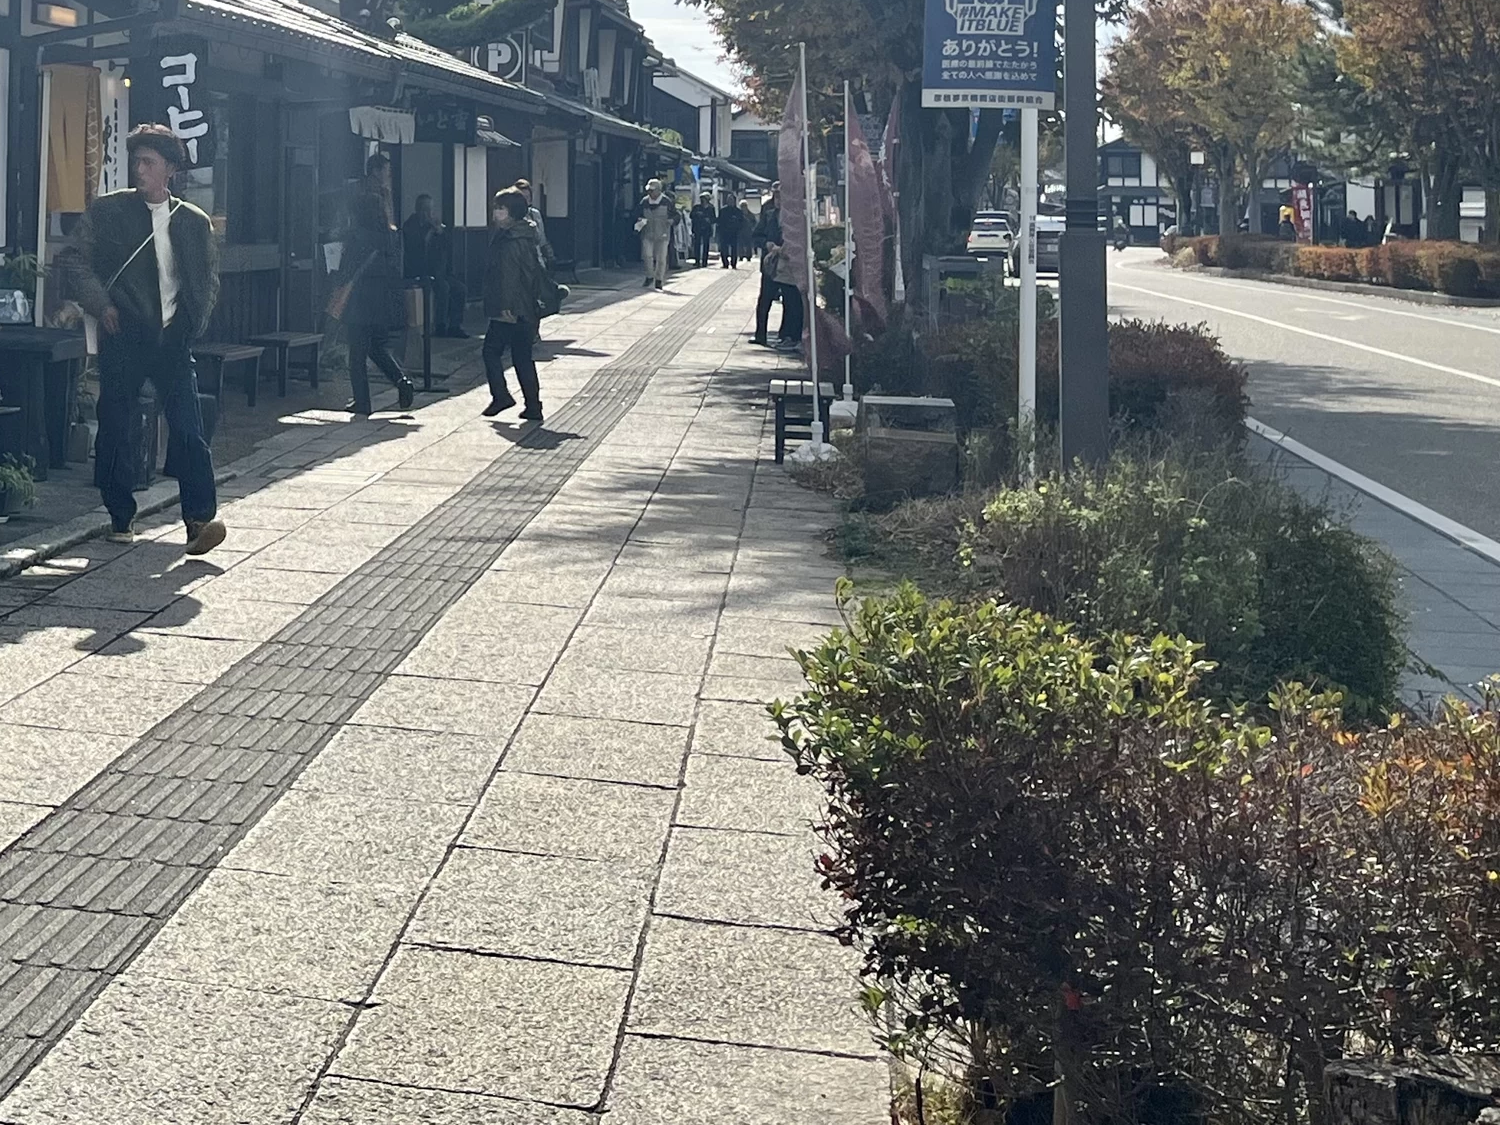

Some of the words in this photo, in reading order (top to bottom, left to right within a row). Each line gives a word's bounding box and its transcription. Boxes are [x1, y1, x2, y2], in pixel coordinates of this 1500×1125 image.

[958, 5, 1024, 20] #MAKE
[959, 18, 1021, 33] ITBLUE
[941, 38, 1040, 58] ありがとう!
[159, 51, 210, 165] コーヒー
